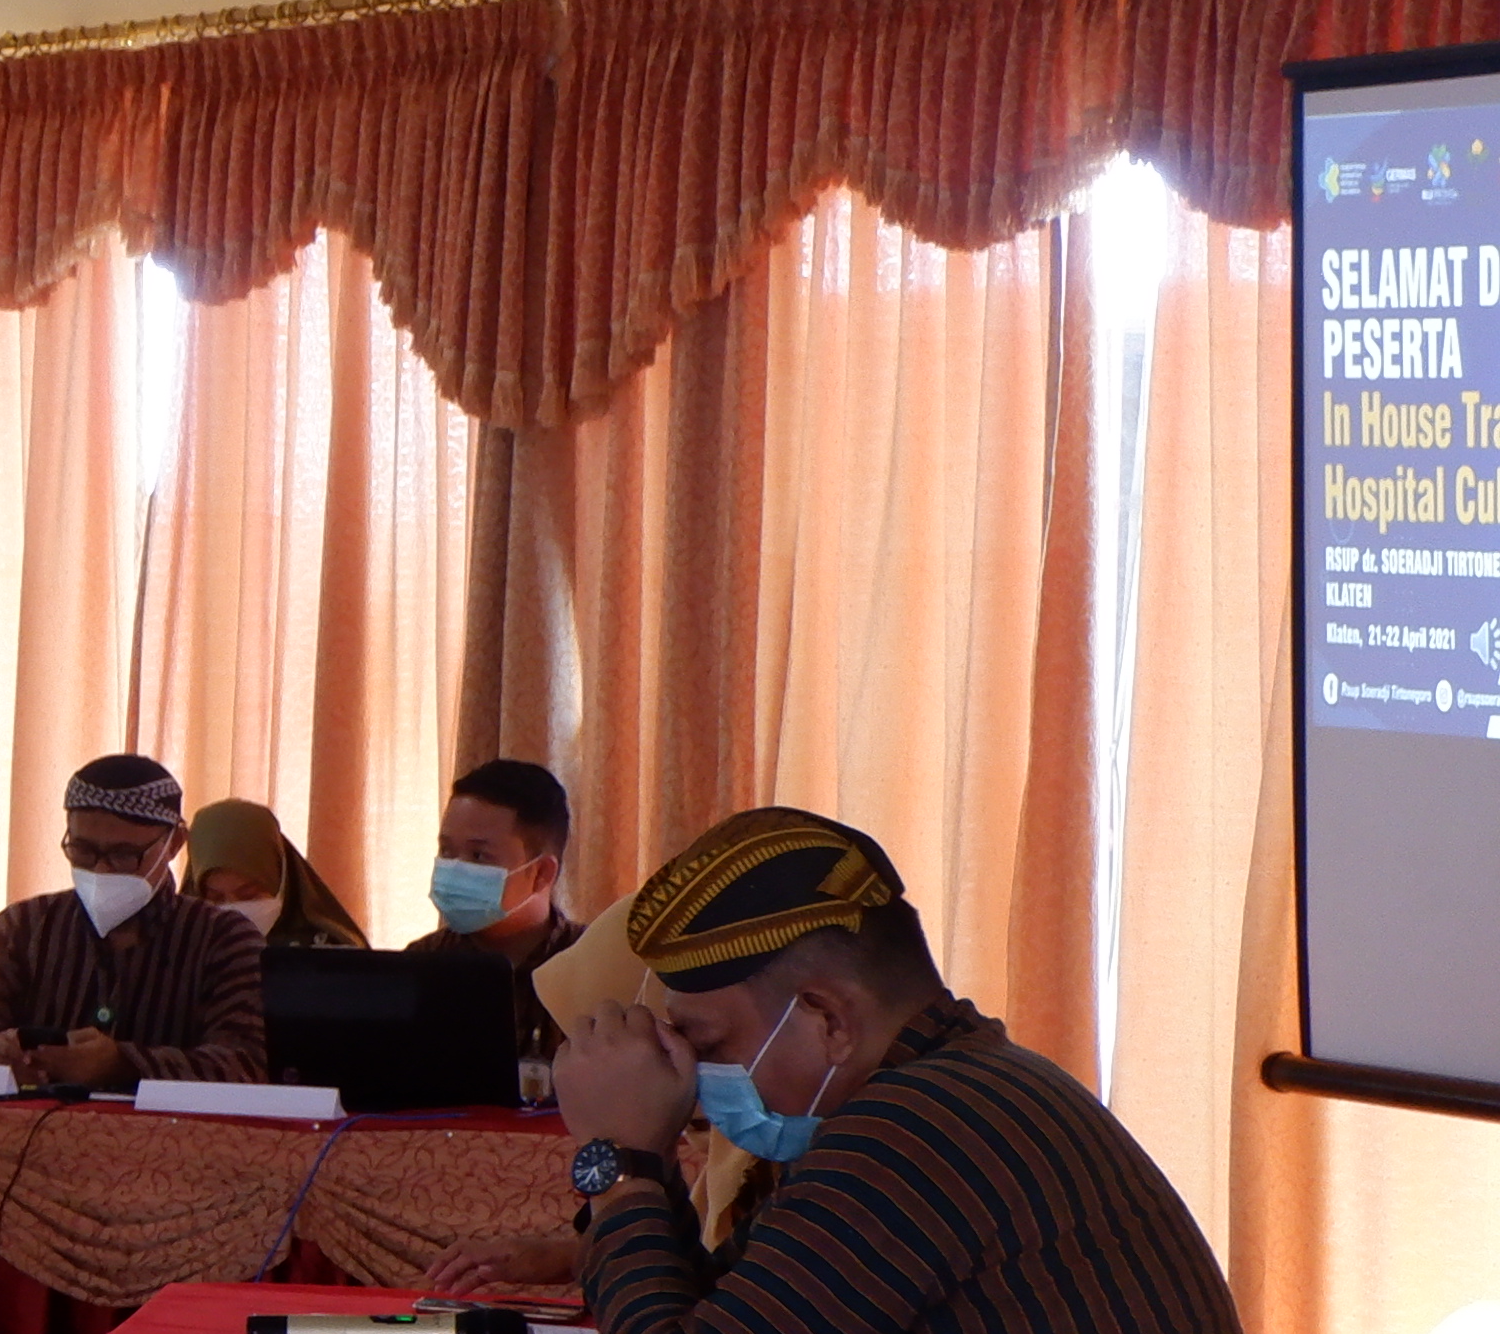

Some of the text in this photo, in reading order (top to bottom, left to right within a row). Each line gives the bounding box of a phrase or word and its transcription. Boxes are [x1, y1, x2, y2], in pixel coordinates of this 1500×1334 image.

[1322, 246, 1468, 310] SELAMAT
[1323, 317, 1463, 380] PESERTA
[1324, 390, 1350, 447] In
[1361, 390, 1452, 449] House
[1325, 463, 1444, 535] Hospital
[1325, 546, 1360, 572] RSUP
[1362, 548, 1378, 574] dr.
[1381, 548, 1443, 576] SOERADJI
[1326, 582, 1372, 608] KLATEN
[1326, 622, 1456, 653] Klaten, 21-22 April 2021
